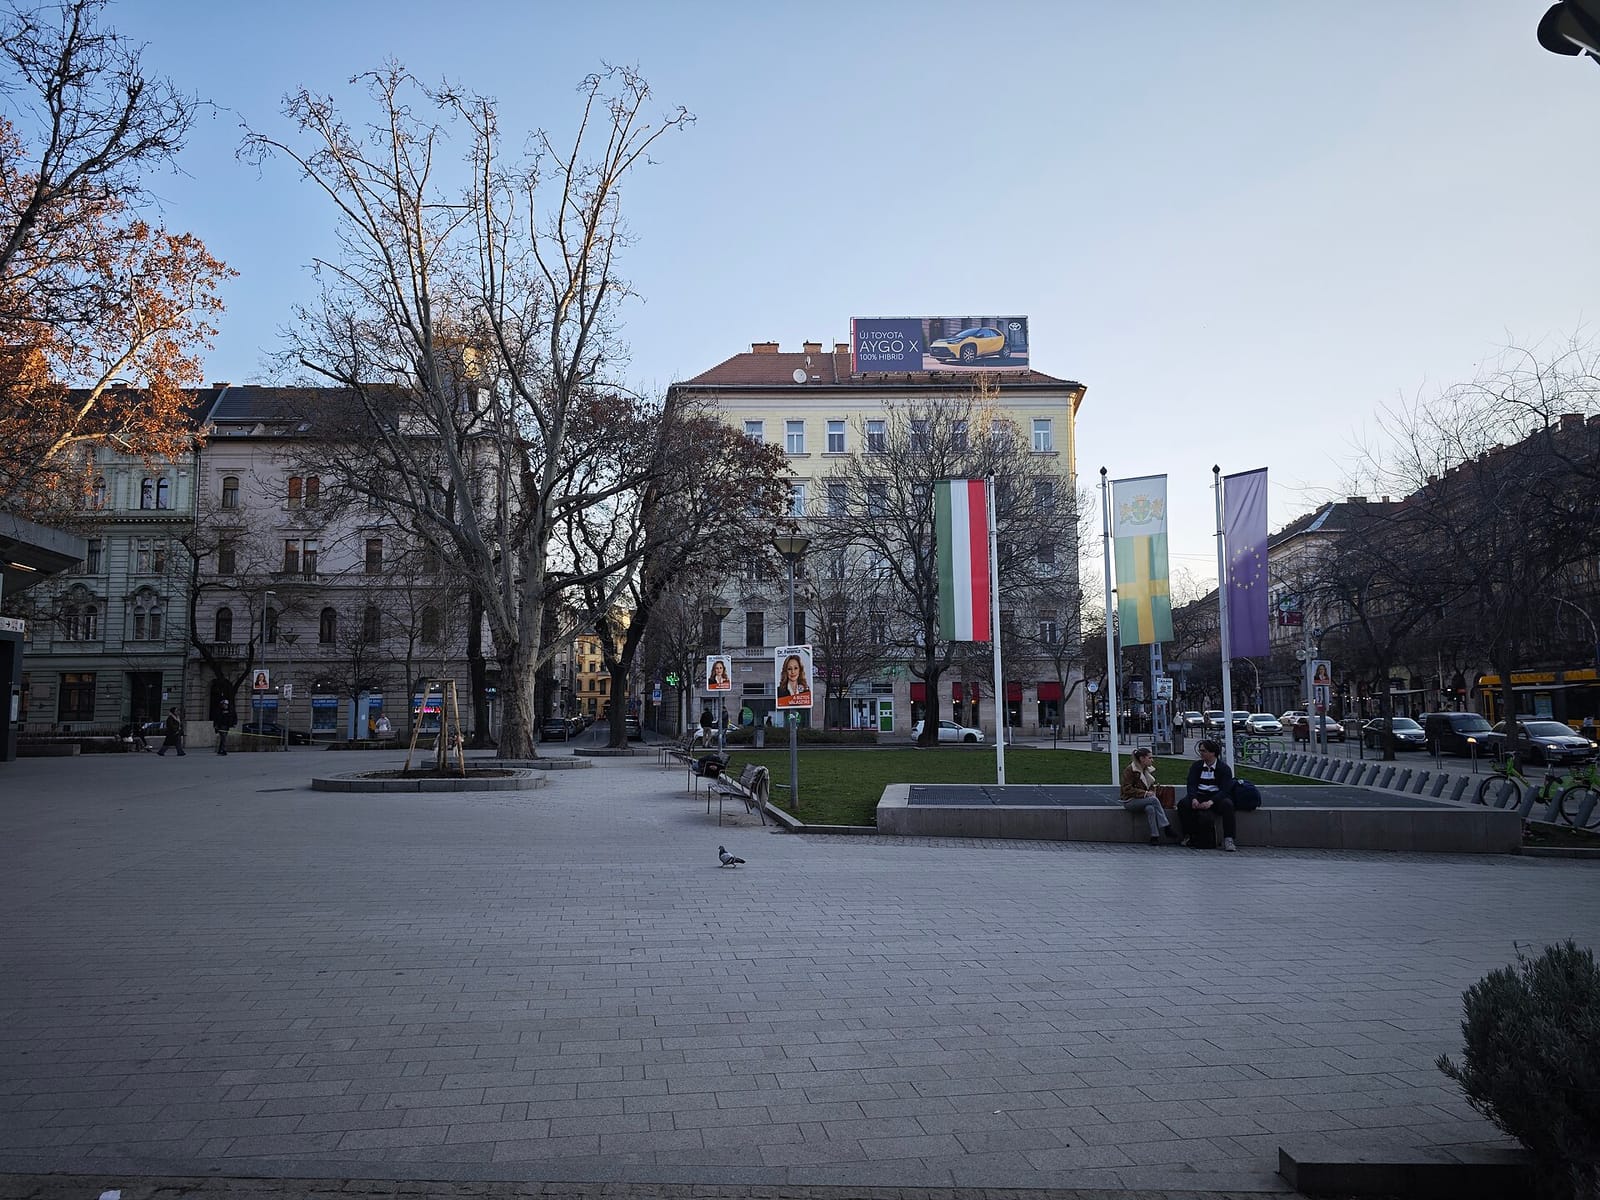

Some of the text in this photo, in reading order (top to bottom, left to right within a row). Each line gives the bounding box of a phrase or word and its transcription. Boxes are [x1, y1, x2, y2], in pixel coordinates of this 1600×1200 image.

[859, 330, 904, 340] ÚJ TOYOTA
[859, 340, 919, 353] AYGO X
[860, 353, 904, 361] 100% HIBRID
